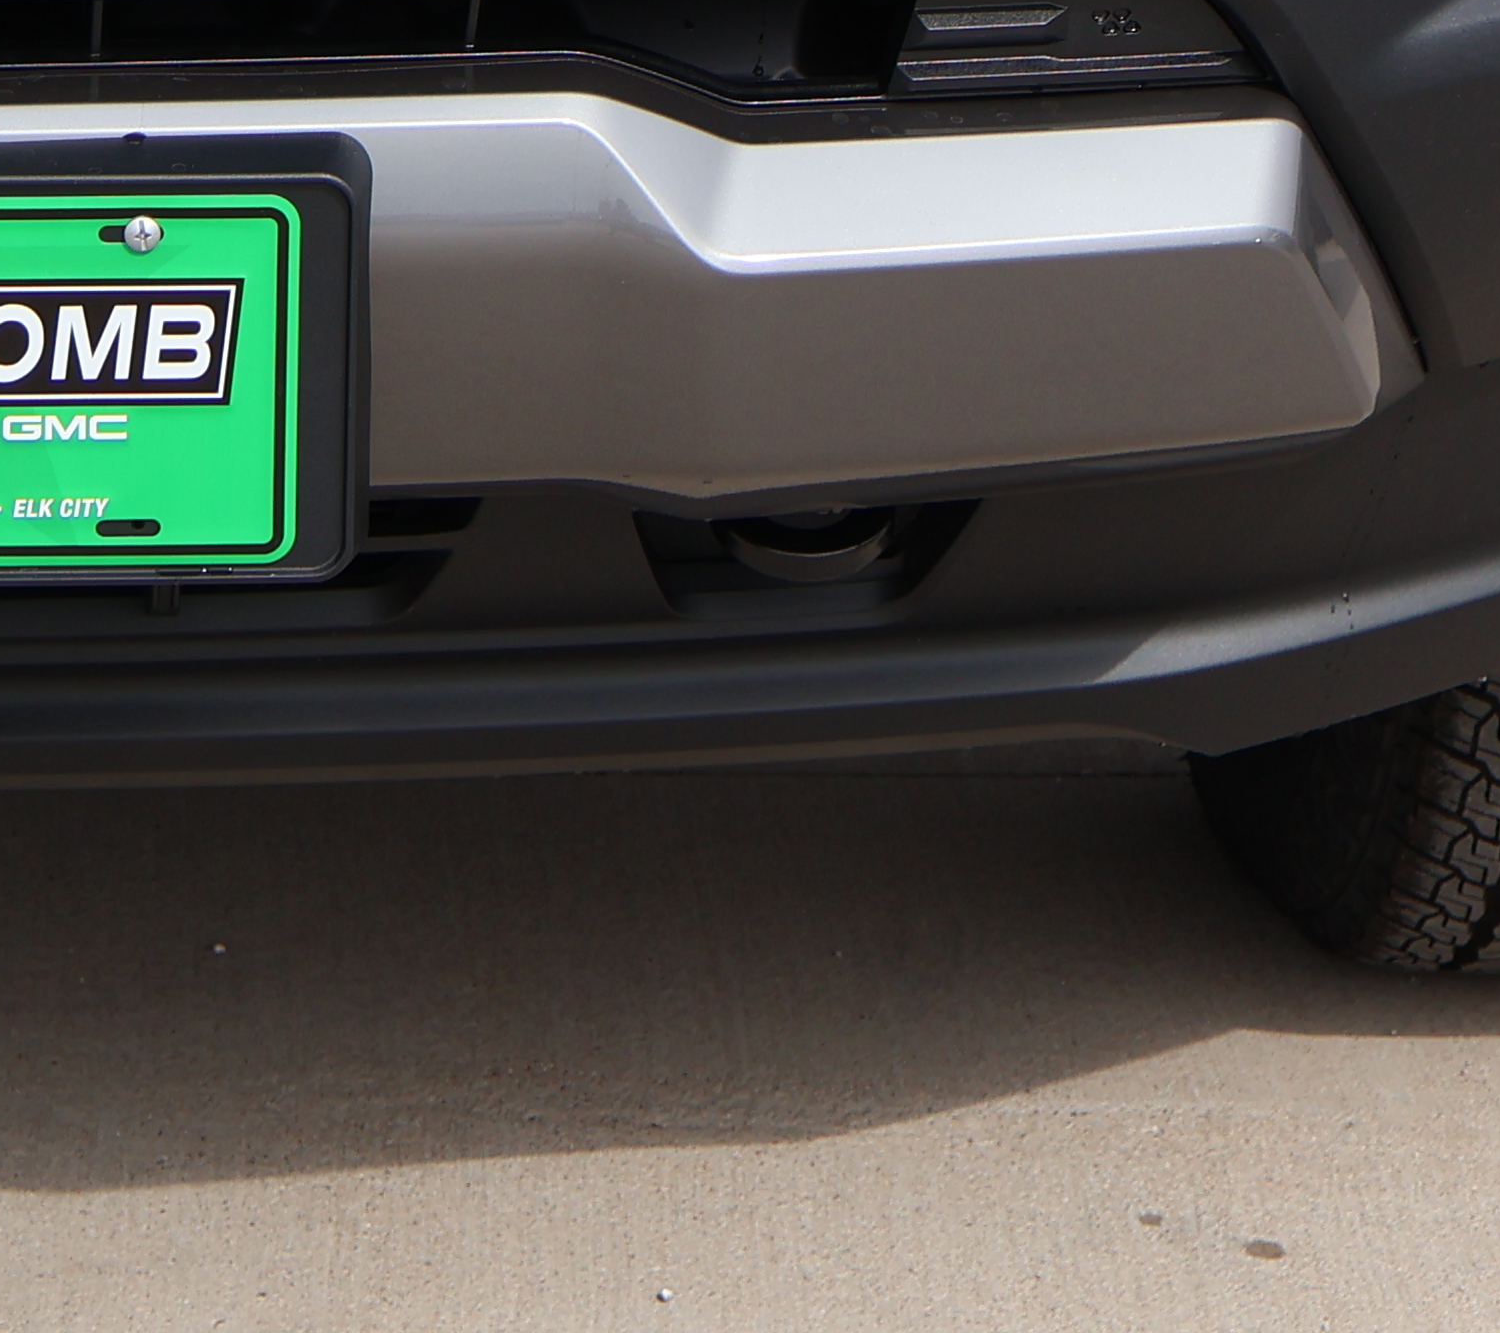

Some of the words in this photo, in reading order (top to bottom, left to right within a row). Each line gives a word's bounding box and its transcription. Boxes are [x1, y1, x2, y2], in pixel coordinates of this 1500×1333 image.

[1, 414, 129, 442] GMC
[12, 497, 54, 519] ELK
[59, 497, 111, 519] CITY
